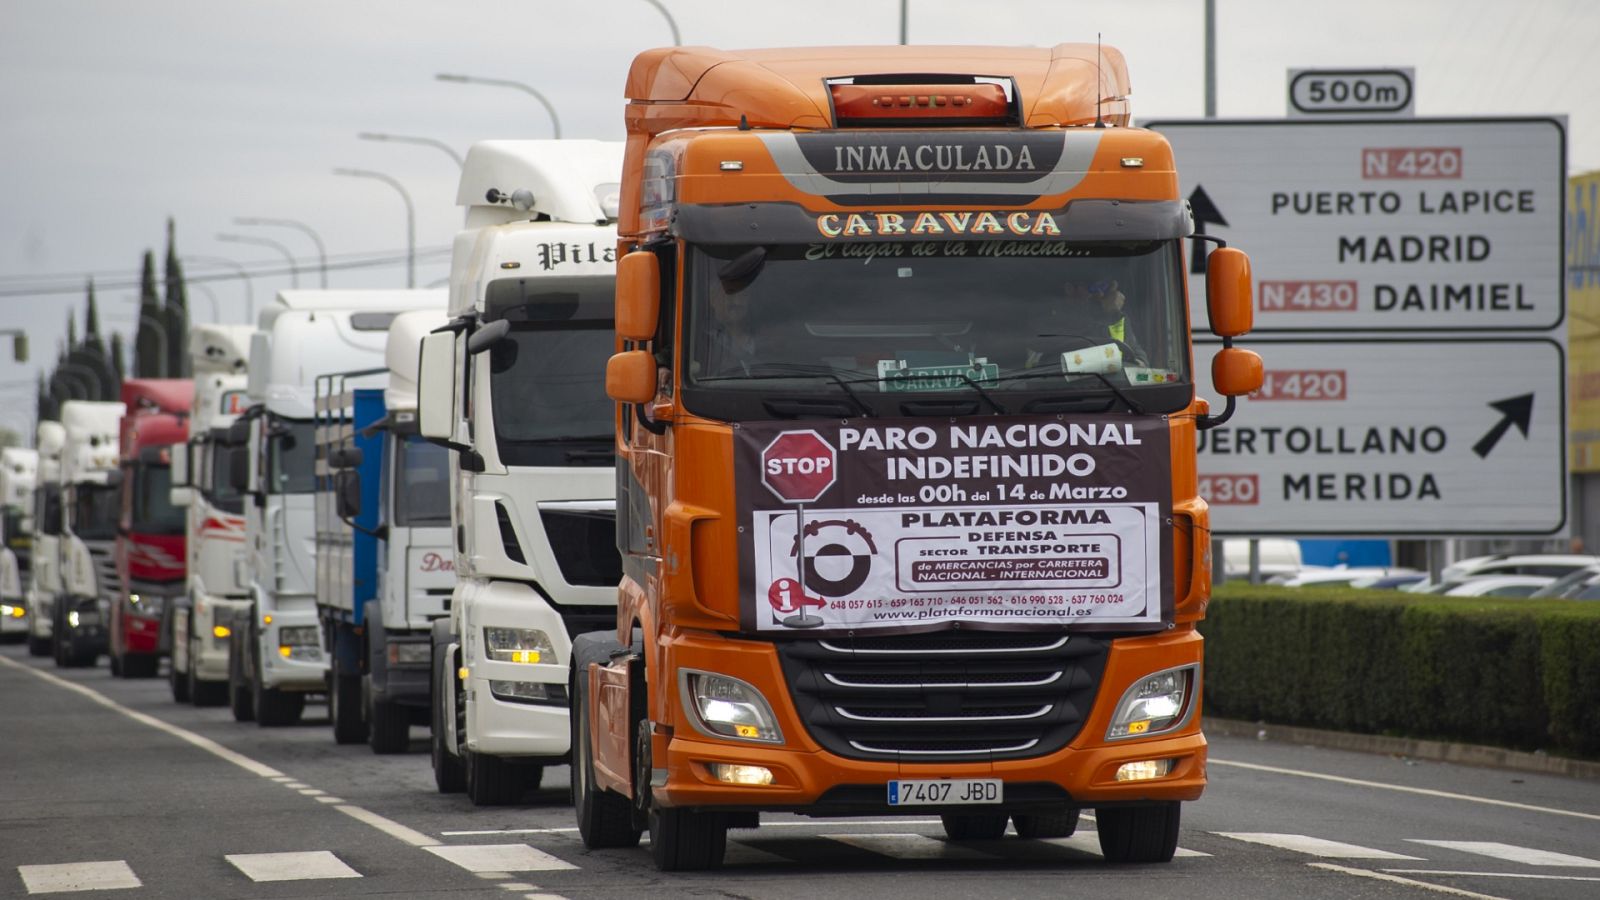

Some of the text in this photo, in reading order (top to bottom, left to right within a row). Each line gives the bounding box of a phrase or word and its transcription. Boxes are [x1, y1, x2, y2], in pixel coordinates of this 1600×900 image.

[1309, 81, 1399, 103] 500m
[834, 145, 1036, 171] INMACULADA
[1271, 190, 1536, 215] PUERTO LAPICE
[817, 212, 1062, 238] CARAVACA
[537, 242, 617, 271] Pila
[805, 241, 834, 260] El
[842, 240, 904, 265] lugar
[911, 240, 935, 257] de
[943, 240, 968, 256] la
[1338, 236, 1491, 263] MADRID
[1374, 284, 1534, 311] DAIMIEL
[839, 423, 1142, 451] PARO NACIONAL
[767, 457, 831, 475] STOP
[886, 453, 1096, 480] INDEFINIDO
[857, 482, 1128, 505] desde las 00h del 14 de Marzo
[1283, 473, 1442, 500] MERIDA
[901, 509, 1112, 528] PLATAFORMA
[968, 530, 1057, 543] DEFENSA
[919, 543, 1101, 557] SECTOR TRANSPORTE
[420, 552, 456, 572] Da
[917, 559, 1103, 571] de MERCANCIAS por CARRETERA
[918, 571, 987, 581] NACIONAL
[1000, 569, 1104, 579] INTERNACIONAL
[830, 600, 846, 610] 648
[848, 600, 864, 610] 057
[867, 600, 882, 609] 615
[890, 599, 907, 608] 659
[909, 598, 925, 607] 165
[927, 597, 943, 606] 710
[950, 596, 966, 604] 646
[968, 595, 984, 604] 051
[987, 595, 1003, 604] 562
[1010, 595, 1027, 604] 616
[1029, 595, 1046, 604] 990
[1049, 595, 1063, 604] 528
[1071, 594, 1087, 604] 637
[1089, 594, 1105, 604] 760
[1107, 594, 1124, 603] 024
[873, 606, 1092, 620] www.plataformanacional.es
[902, 783, 952, 802] 7407
[960, 782, 997, 801] JBD
